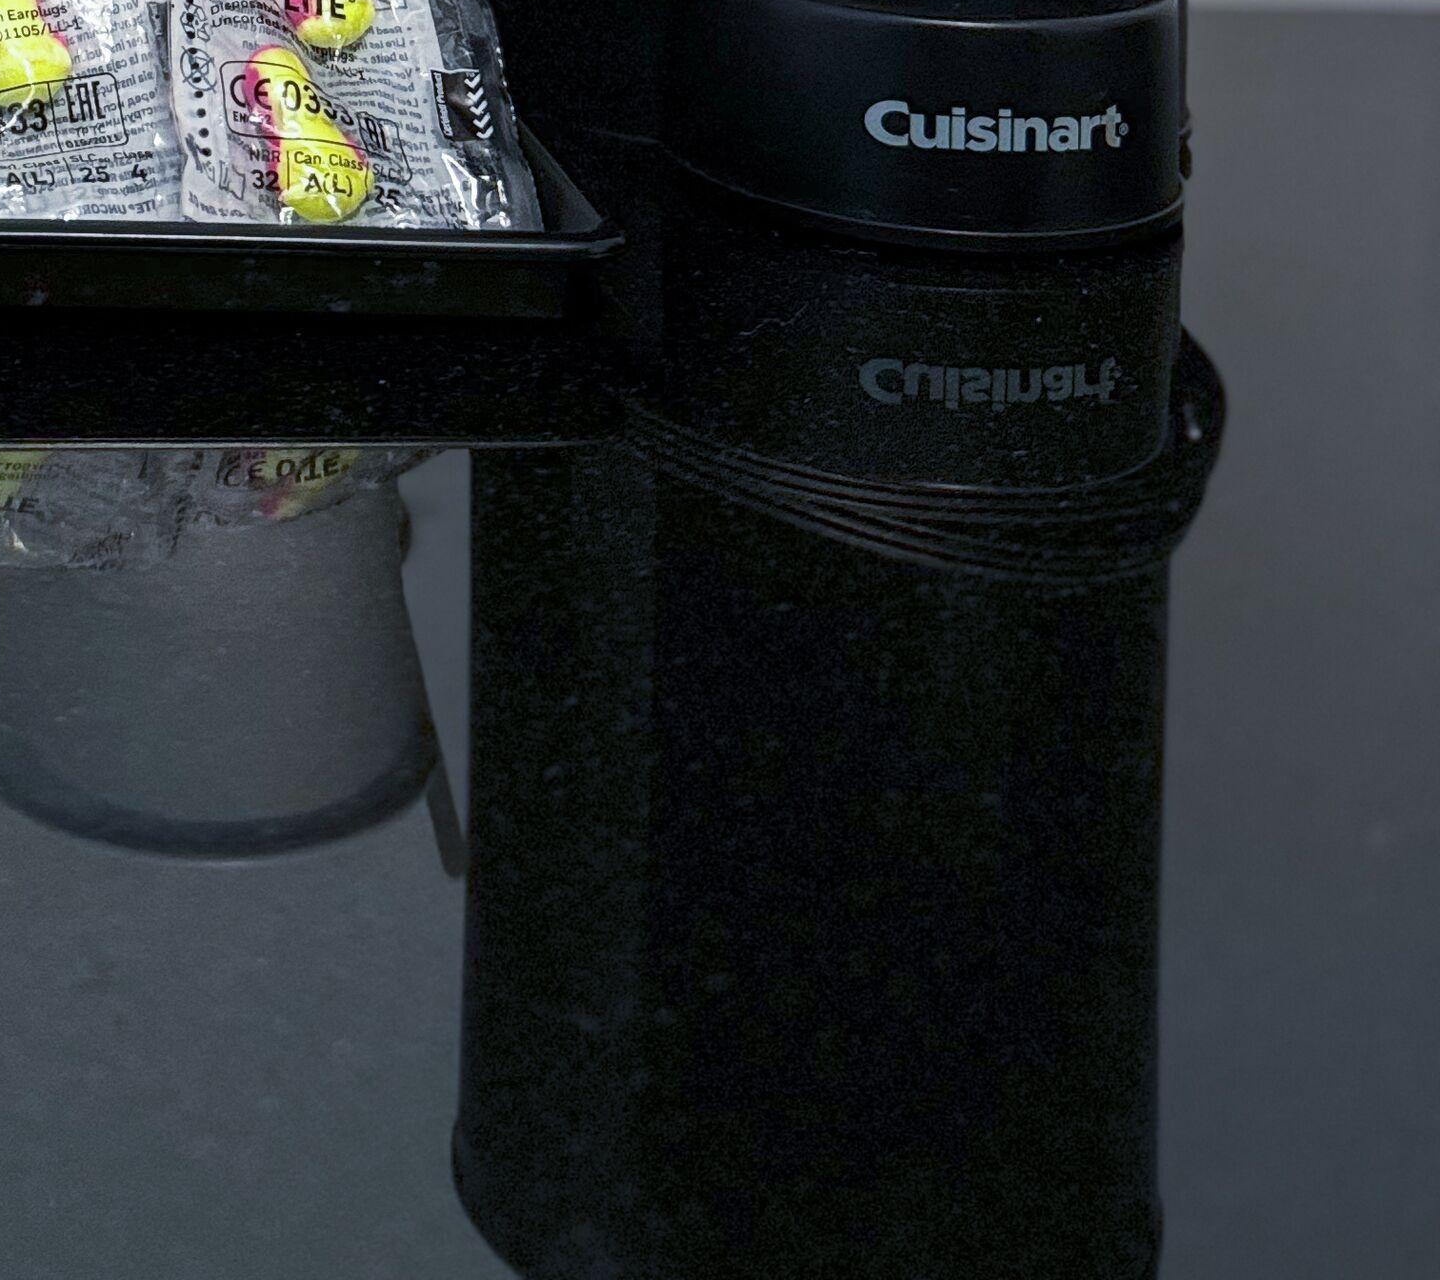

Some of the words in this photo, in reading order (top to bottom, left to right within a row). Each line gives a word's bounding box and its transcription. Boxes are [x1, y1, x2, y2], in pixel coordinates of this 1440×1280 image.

[8, 4, 68, 22] Earplugs
[329, 154, 364, 171] Class
[251, 169, 280, 192] 32
